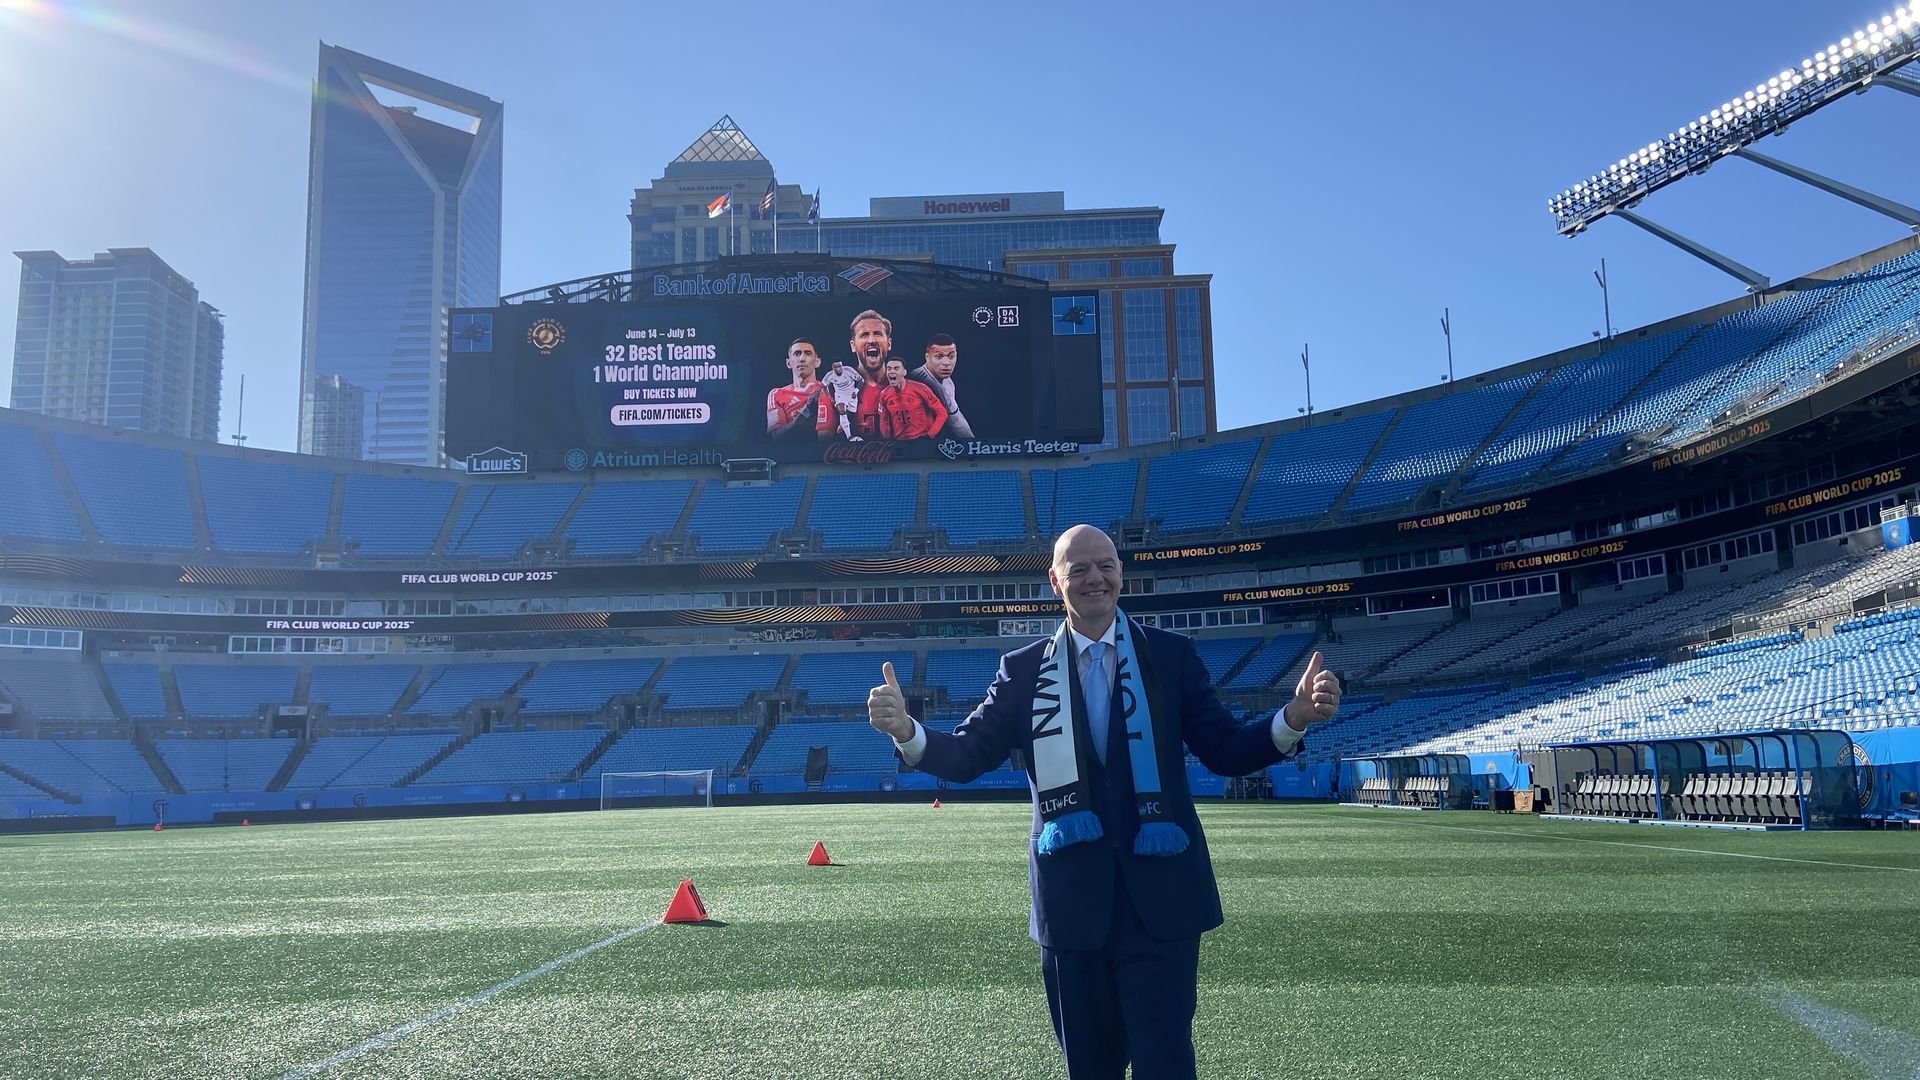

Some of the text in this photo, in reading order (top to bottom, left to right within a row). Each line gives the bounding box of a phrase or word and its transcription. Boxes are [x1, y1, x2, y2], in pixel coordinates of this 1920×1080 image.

[924, 197, 1010, 214] Honeywell
[654, 272, 830, 296] Bank of America
[626, 330, 646, 339] June
[648, 329, 657, 338] 14
[667, 328, 684, 338] July
[686, 328, 696, 338] 13
[605, 343, 716, 362] 32 Best Teams
[593, 362, 728, 382] 1 World Champion
[624, 388, 697, 400] BUY TICKETS NOW
[619, 408, 702, 421] FIFA.COM/TICKETS
[968, 440, 1078, 455] Harris Teeter
[1652, 458, 1672, 471] FIFA
[1672, 449, 1695, 464] CLUB
[1697, 438, 1728, 457] WORLD
[1729, 429, 1746, 444] CUP
[472, 457, 521, 472] LOWE'S
[592, 449, 722, 467] Atrium Health
[1765, 502, 1787, 517] FIFA
[1788, 494, 1812, 510] CLUB
[1813, 483, 1850, 503] WORLD
[1852, 477, 1872, 492] CUP
[1398, 520, 1419, 531] FIFA
[1420, 516, 1445, 528] CLUB
[1446, 509, 1480, 523] WORLD
[1482, 504, 1501, 516] CUP
[1134, 552, 1154, 560] FIFA
[1156, 550, 1179, 560] CLUB
[1180, 547, 1216, 558] WORLD
[1218, 545, 1236, 554] CUP
[1496, 561, 1516, 572] FIFA
[1517, 556, 1542, 568] CLUB
[1543, 550, 1580, 564] WORLD
[1581, 546, 1599, 558] CUP
[401, 574, 426, 584] FIFA
[428, 574, 458, 584] CLUB
[460, 573, 500, 583] WORLD
[502, 572, 524, 582] CUP
[1224, 593, 1244, 601] FIFA
[1245, 591, 1269, 600] CLUB
[1270, 587, 1303, 598] WORLD
[1305, 586, 1324, 594] CUP
[981, 605, 1004, 613] CLUB
[1006, 604, 1038, 612] WORLD
[266, 621, 290, 629] FIFA
[292, 621, 320, 629] CLUB
[322, 621, 360, 630] WORLD
[362, 621, 382, 629] CUP
[1147, 802, 1161, 814] FC
